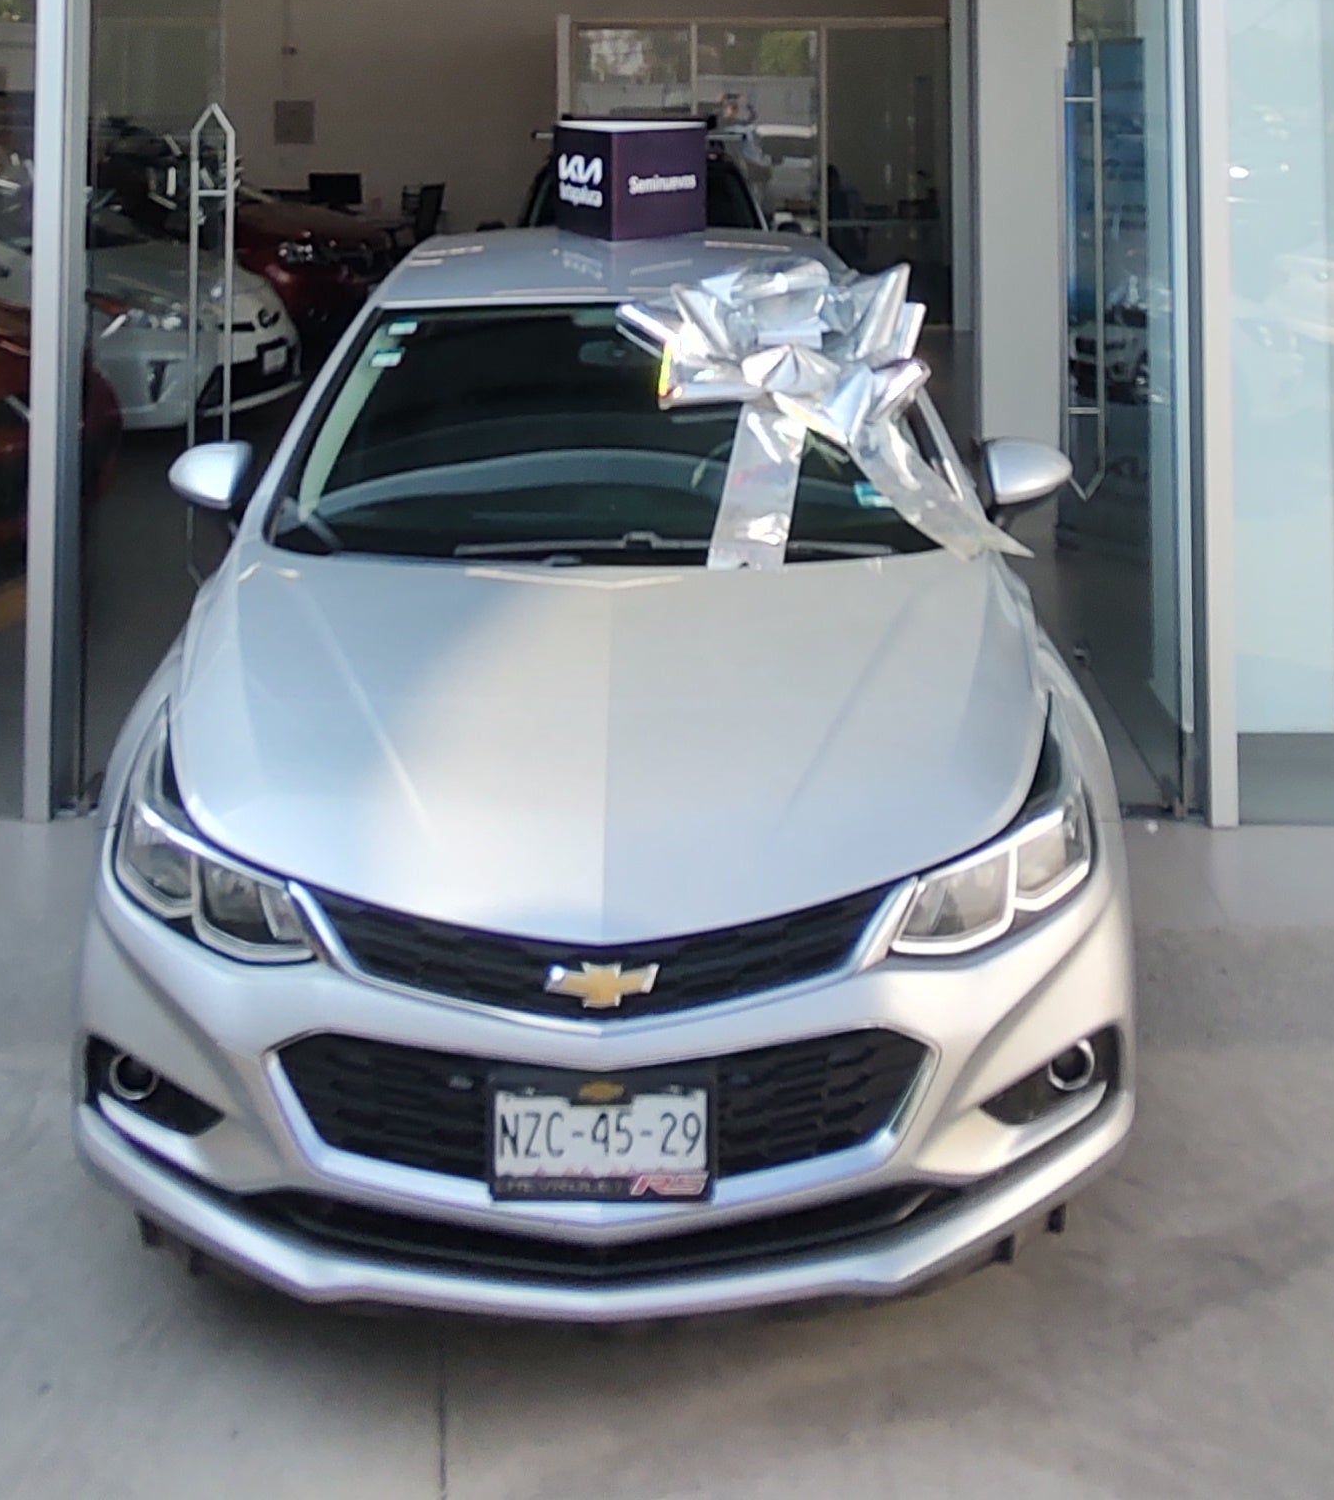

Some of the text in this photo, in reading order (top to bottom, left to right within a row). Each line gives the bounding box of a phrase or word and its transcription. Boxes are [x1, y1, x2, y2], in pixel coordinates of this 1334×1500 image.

[558, 153, 603, 186] KIA
[628, 174, 697, 195] Seminuevos
[499, 1110, 702, 1159] NZC-45-29
